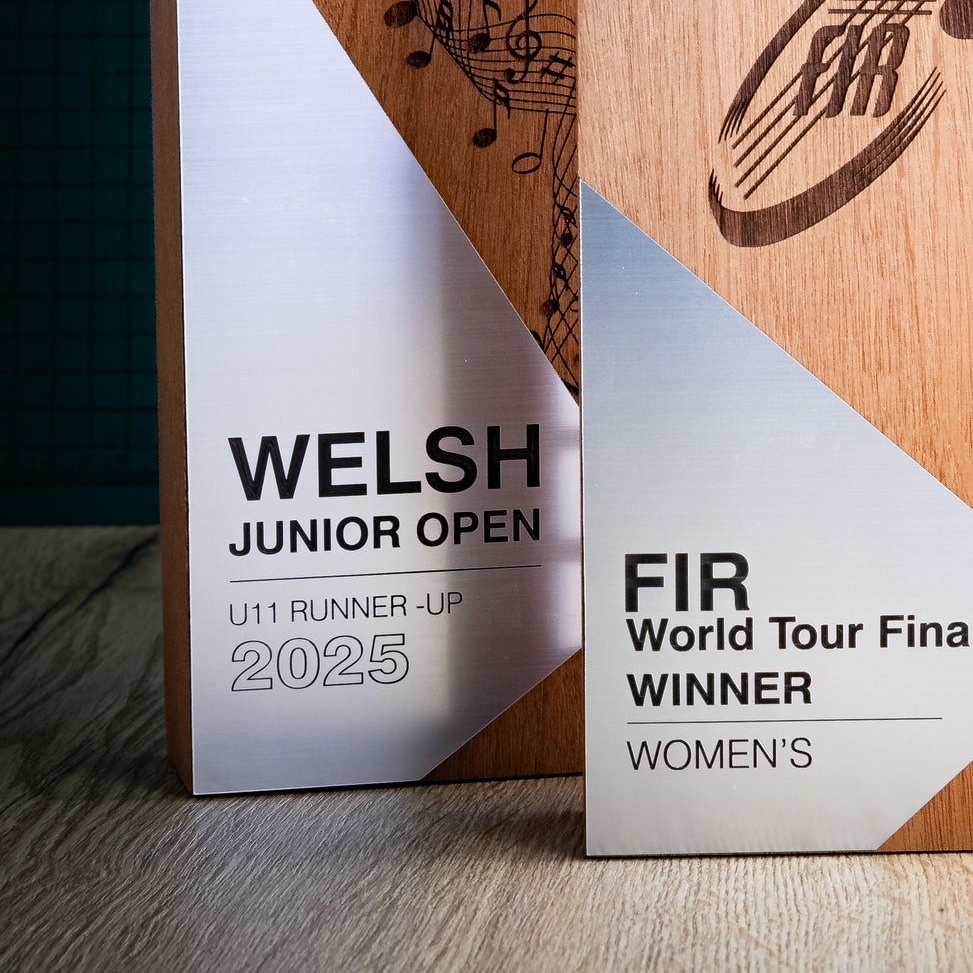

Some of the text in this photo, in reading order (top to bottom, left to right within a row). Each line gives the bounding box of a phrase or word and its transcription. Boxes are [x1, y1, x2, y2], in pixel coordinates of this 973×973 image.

[792, 23, 910, 118] FIR
[227, 424, 541, 501] WELSH
[228, 508, 541, 557] JUNIOR OPEN
[624, 552, 751, 612] FIR
[229, 602, 277, 626] U11
[290, 594, 407, 623] RUNNER
[626, 616, 754, 651] World
[769, 615, 864, 649] Tour
[231, 633, 410, 692] 2025
[626, 671, 813, 707] WINNER
[626, 737, 813, 770] WOMEN'S
